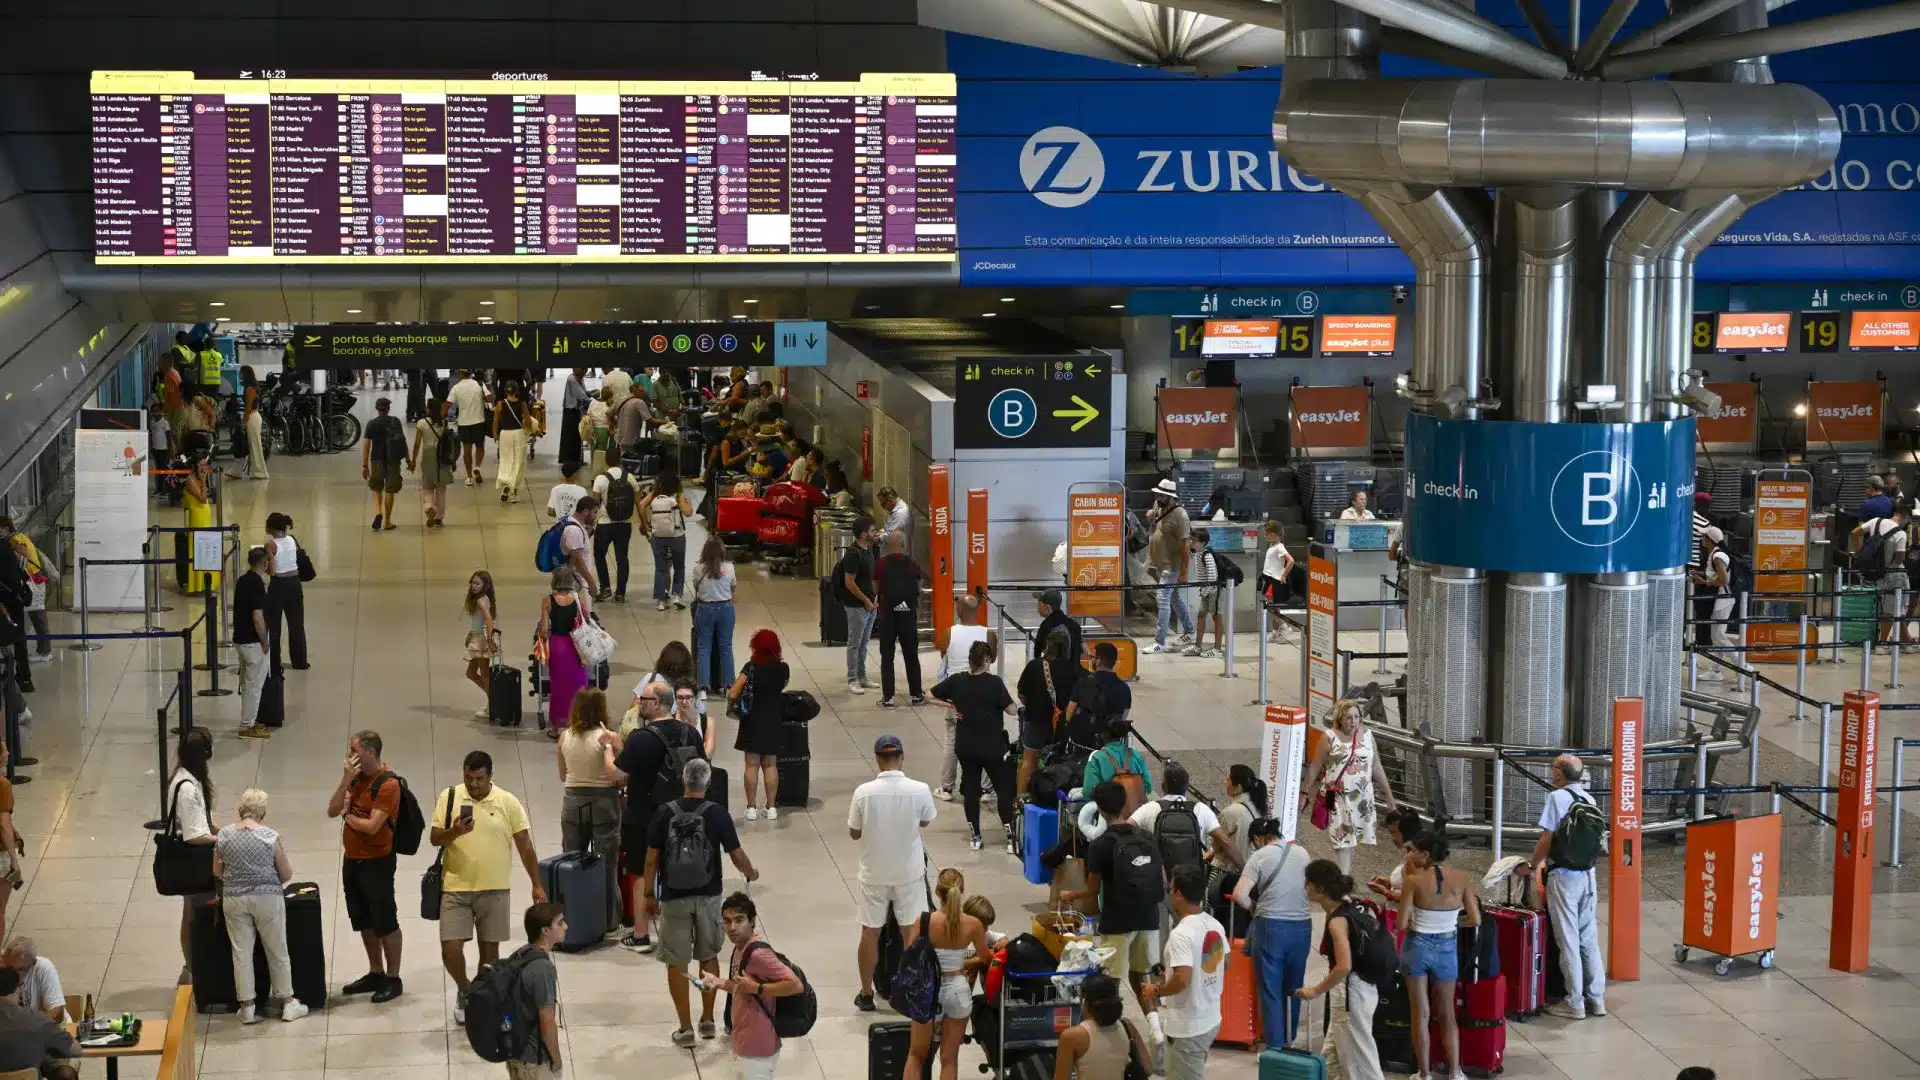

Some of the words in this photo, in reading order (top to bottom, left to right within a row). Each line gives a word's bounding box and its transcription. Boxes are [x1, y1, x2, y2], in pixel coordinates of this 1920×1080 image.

[261, 70, 286, 79] 16:23
[492, 71, 548, 80] departures
[1136, 150, 1341, 192] ZURIC
[1024, 236, 1048, 246] Esta
[1050, 236, 1122, 247] comunicação
[1124, 236, 1132, 245] é
[1134, 234, 1147, 245] da
[1150, 234, 1182, 245] inteira
[1185, 234, 1274, 247] responsabilidade
[1278, 234, 1290, 244] da
[1293, 234, 1329, 244] Zurich
[1332, 234, 1385, 244] Insurance
[1718, 233, 1761, 243] Seguros
[1764, 232, 1791, 243] Vida,
[1818, 232, 1870, 243] registadas
[1888, 232, 1909, 242] ASF
[973, 261, 1016, 270] JCDecaux
[1232, 295, 1264, 308] check
[1267, 295, 1281, 307] in
[1840, 290, 1874, 301] check
[1878, 290, 1888, 300] in
[333, 335, 369, 345] portas
[372, 334, 386, 343] de
[390, 334, 448, 345] embarque
[1175, 325, 1202, 350] 14
[1279, 325, 1309, 350] 15
[1693, 322, 1710, 347] 8
[1722, 322, 1785, 338] easyJet
[1804, 321, 1837, 346] 19
[333, 346, 381, 356] boarding
[384, 347, 414, 357] gates
[580, 339, 613, 349] check
[616, 339, 626, 348] in
[1326, 338, 1368, 348] easyJet
[1370, 339, 1390, 348] plus
[991, 367, 1023, 376] check
[1026, 367, 1034, 375] in
[1004, 400, 1023, 427] B
[1166, 411, 1227, 426] easyJet
[1300, 410, 1360, 424] easyJet
[1816, 404, 1872, 420] easyJet
[1424, 480, 1460, 498] check
[1464, 485, 1478, 499] in
[1582, 472, 1618, 526] B
[1075, 498, 1097, 507] CABIN
[1098, 498, 1118, 507] BAGS
[936, 506, 948, 535] SAIDA
[972, 532, 985, 554] EXIT
[1310, 570, 1334, 585] easyJet
[1846, 709, 1861, 741] DROP
[1866, 709, 1877, 751] BAGAGEM
[1270, 728, 1281, 782] ASSISTANCE
[1622, 720, 1636, 771] BOARDING
[1845, 743, 1858, 767] BAG
[1866, 751, 1874, 765] DE
[1621, 774, 1635, 812] SPEEDY
[1864, 768, 1873, 806] ENTREGA
[1266, 786, 1276, 820] SPECIAL
[1701, 849, 1717, 937] easyJet
[1749, 852, 1764, 940] easyJet
